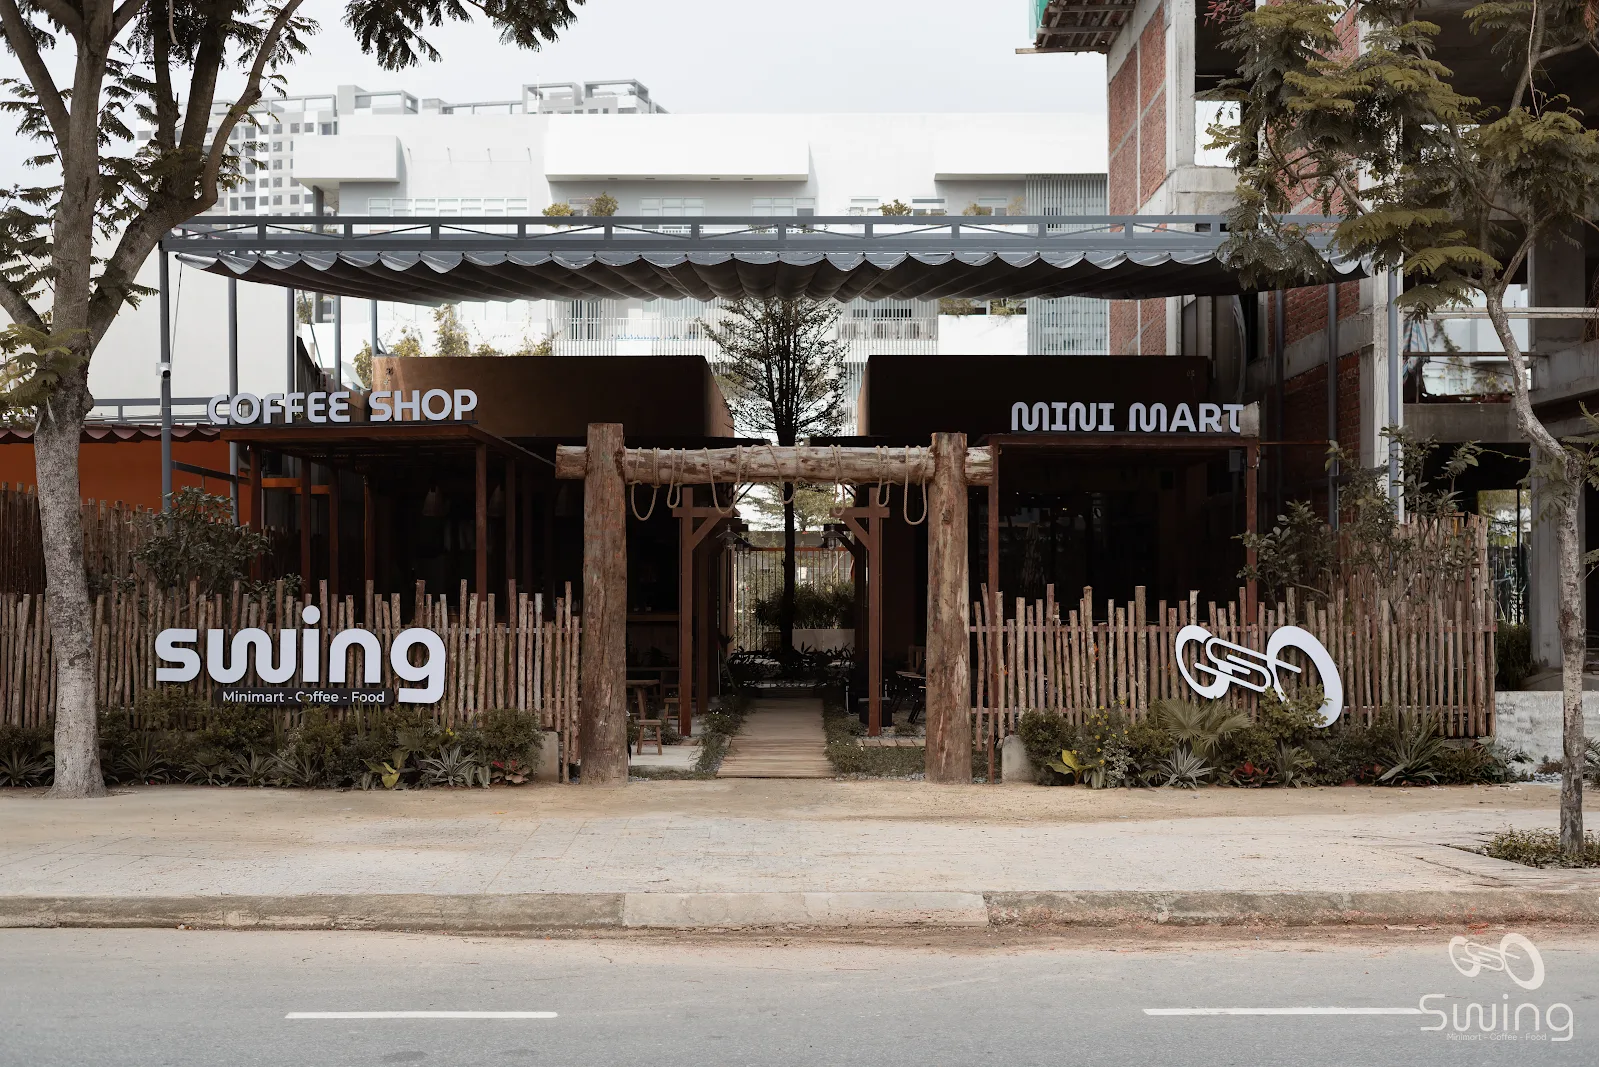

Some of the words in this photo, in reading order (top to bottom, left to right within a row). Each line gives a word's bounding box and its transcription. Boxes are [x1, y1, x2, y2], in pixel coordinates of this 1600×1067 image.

[207, 391, 350, 424] COFFEE
[369, 388, 478, 422] SHOP
[1011, 401, 1115, 431] MINI
[1128, 402, 1244, 433] MART
[222, 691, 284, 703] Minimart
[351, 691, 385, 703] Food
